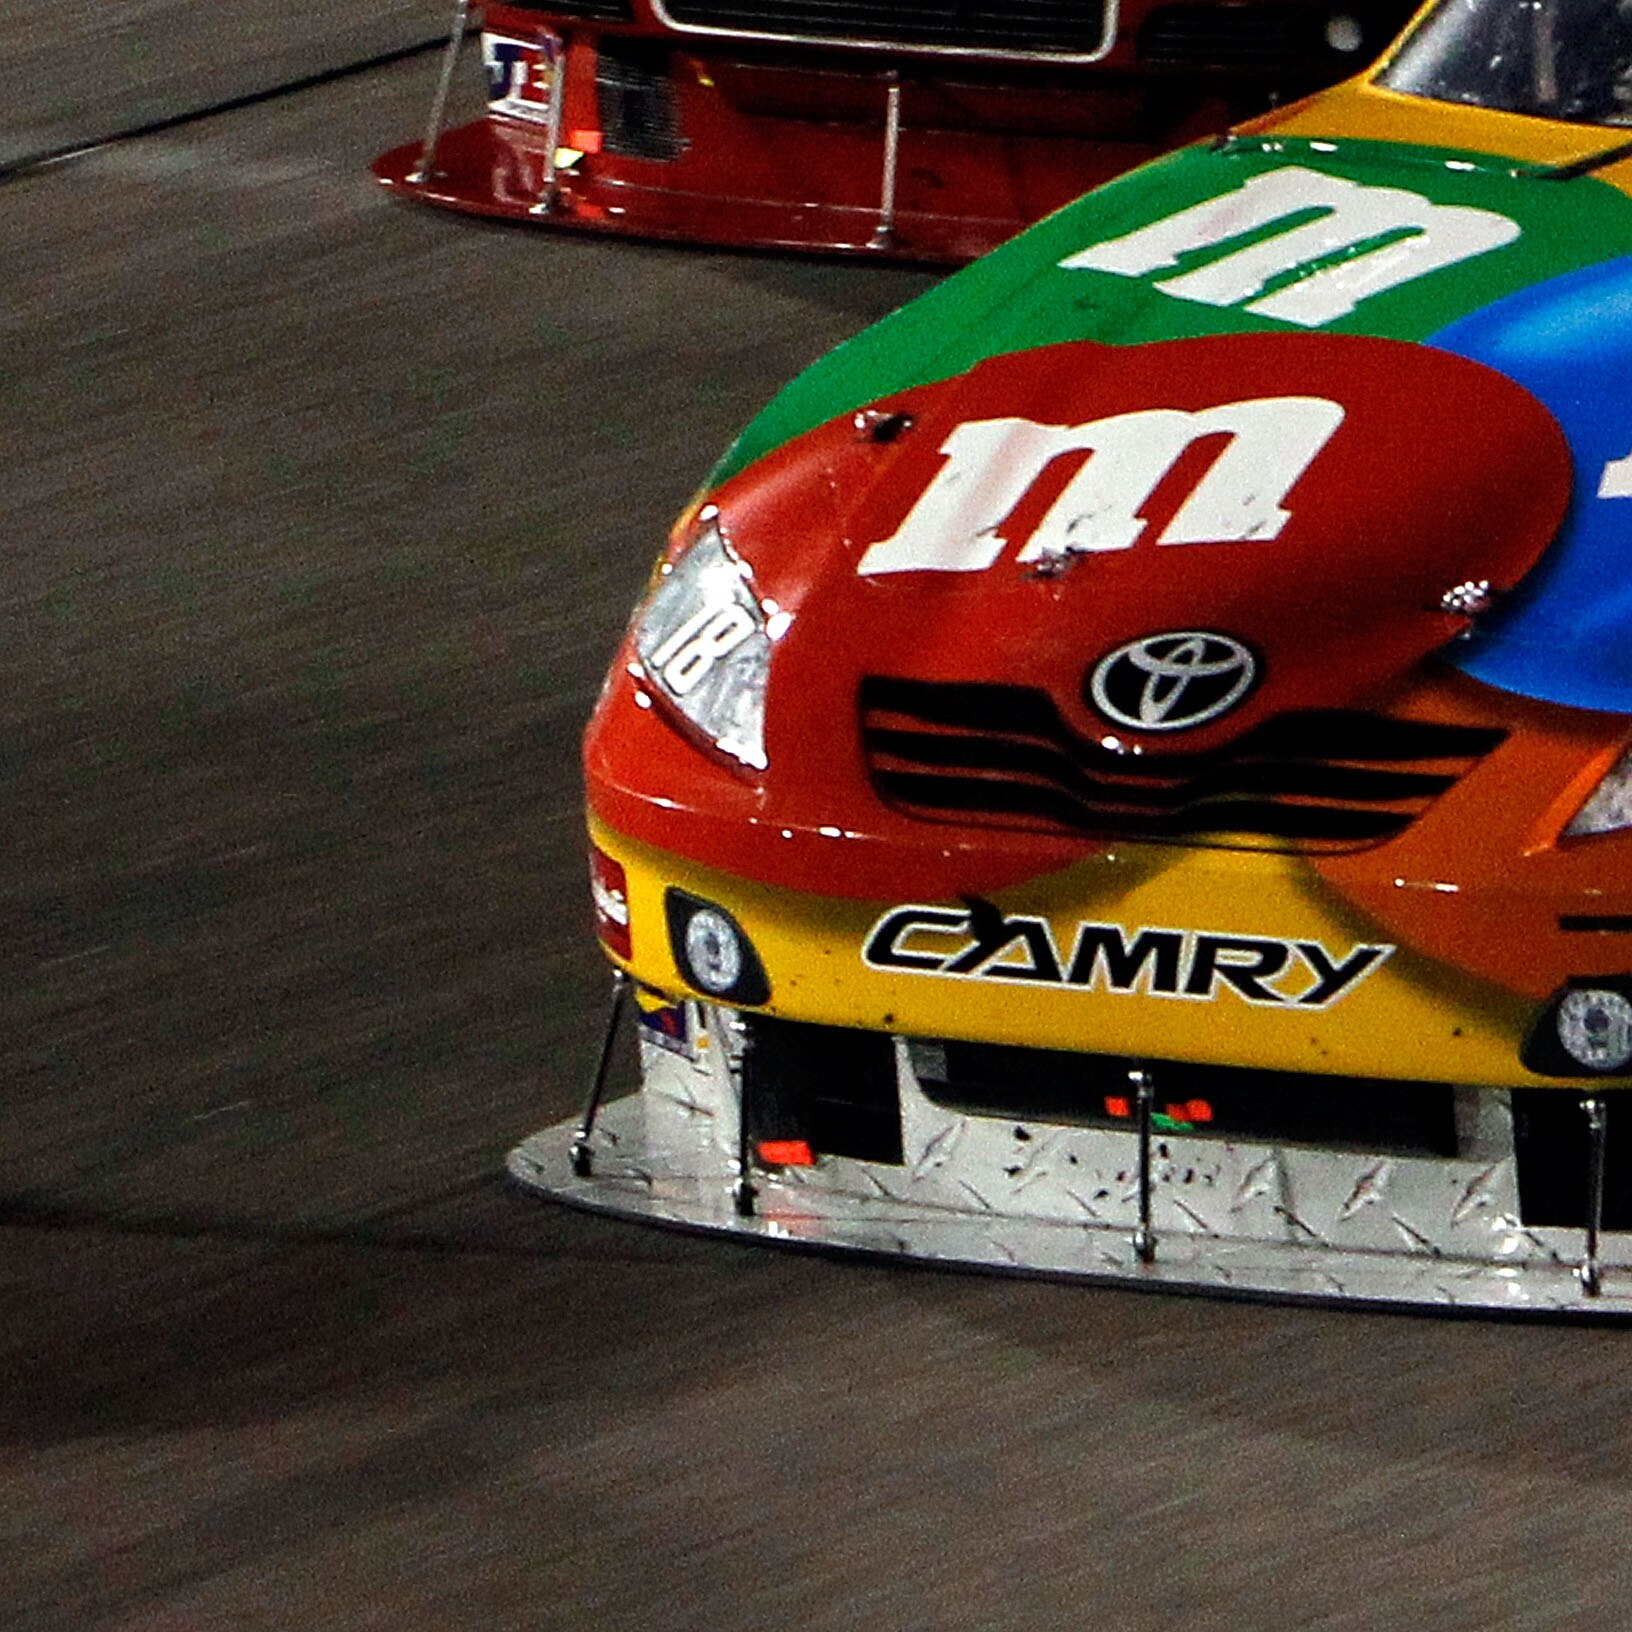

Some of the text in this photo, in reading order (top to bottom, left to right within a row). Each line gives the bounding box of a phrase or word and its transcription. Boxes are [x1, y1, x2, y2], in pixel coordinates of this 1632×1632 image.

[1058, 166, 1523, 329] m
[857, 396, 1346, 576] m
[648, 601, 757, 697] 18
[861, 898, 1397, 1010] CAMRY
